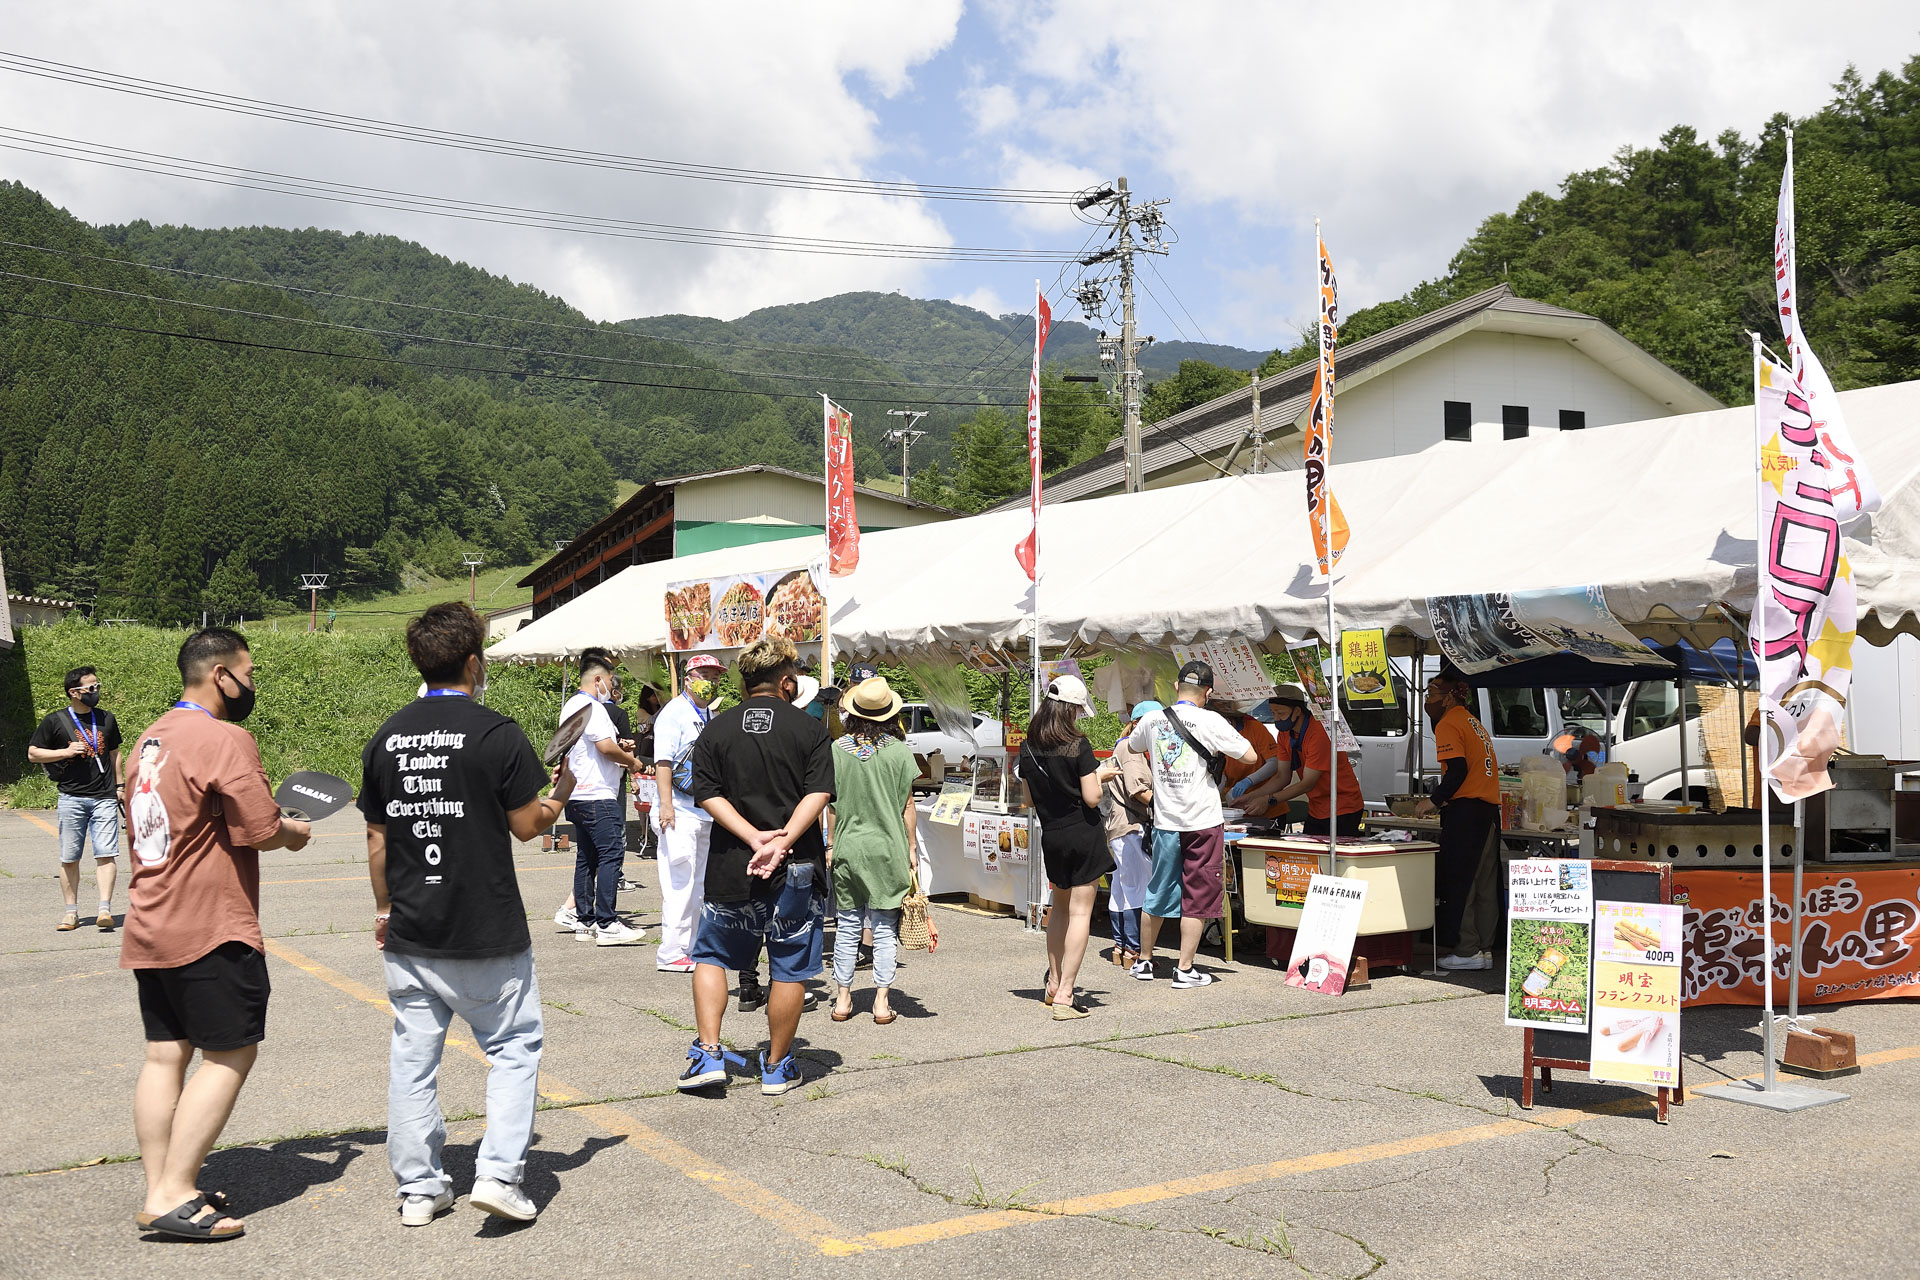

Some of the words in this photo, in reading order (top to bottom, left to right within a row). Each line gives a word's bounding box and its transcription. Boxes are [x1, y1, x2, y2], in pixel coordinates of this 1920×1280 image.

[718, 606, 759, 622] 焼きそば
[1348, 641, 1379, 659] 鶏排
[386, 730, 466, 751] Everything
[396, 753, 449, 772] Louder
[402, 775, 442, 795] Than
[386, 798, 465, 818] Everything
[412, 821, 442, 839] Else
[1281, 863, 1316, 876] 明宝ハム
[1510, 864, 1553, 875] 明宝ハム
[1511, 877, 1556, 886] お買い上げで
[1598, 904, 1645, 918] チュロス
[1540, 925, 1564, 936] 岐阜の
[1533, 935, 1571, 946] うまいもの
[1645, 950, 1674, 962] 400円
[1618, 971, 1653, 988] 明宝
[1523, 997, 1582, 1013] 明宝ハム
[1597, 990, 1678, 1006] フランクフルト
